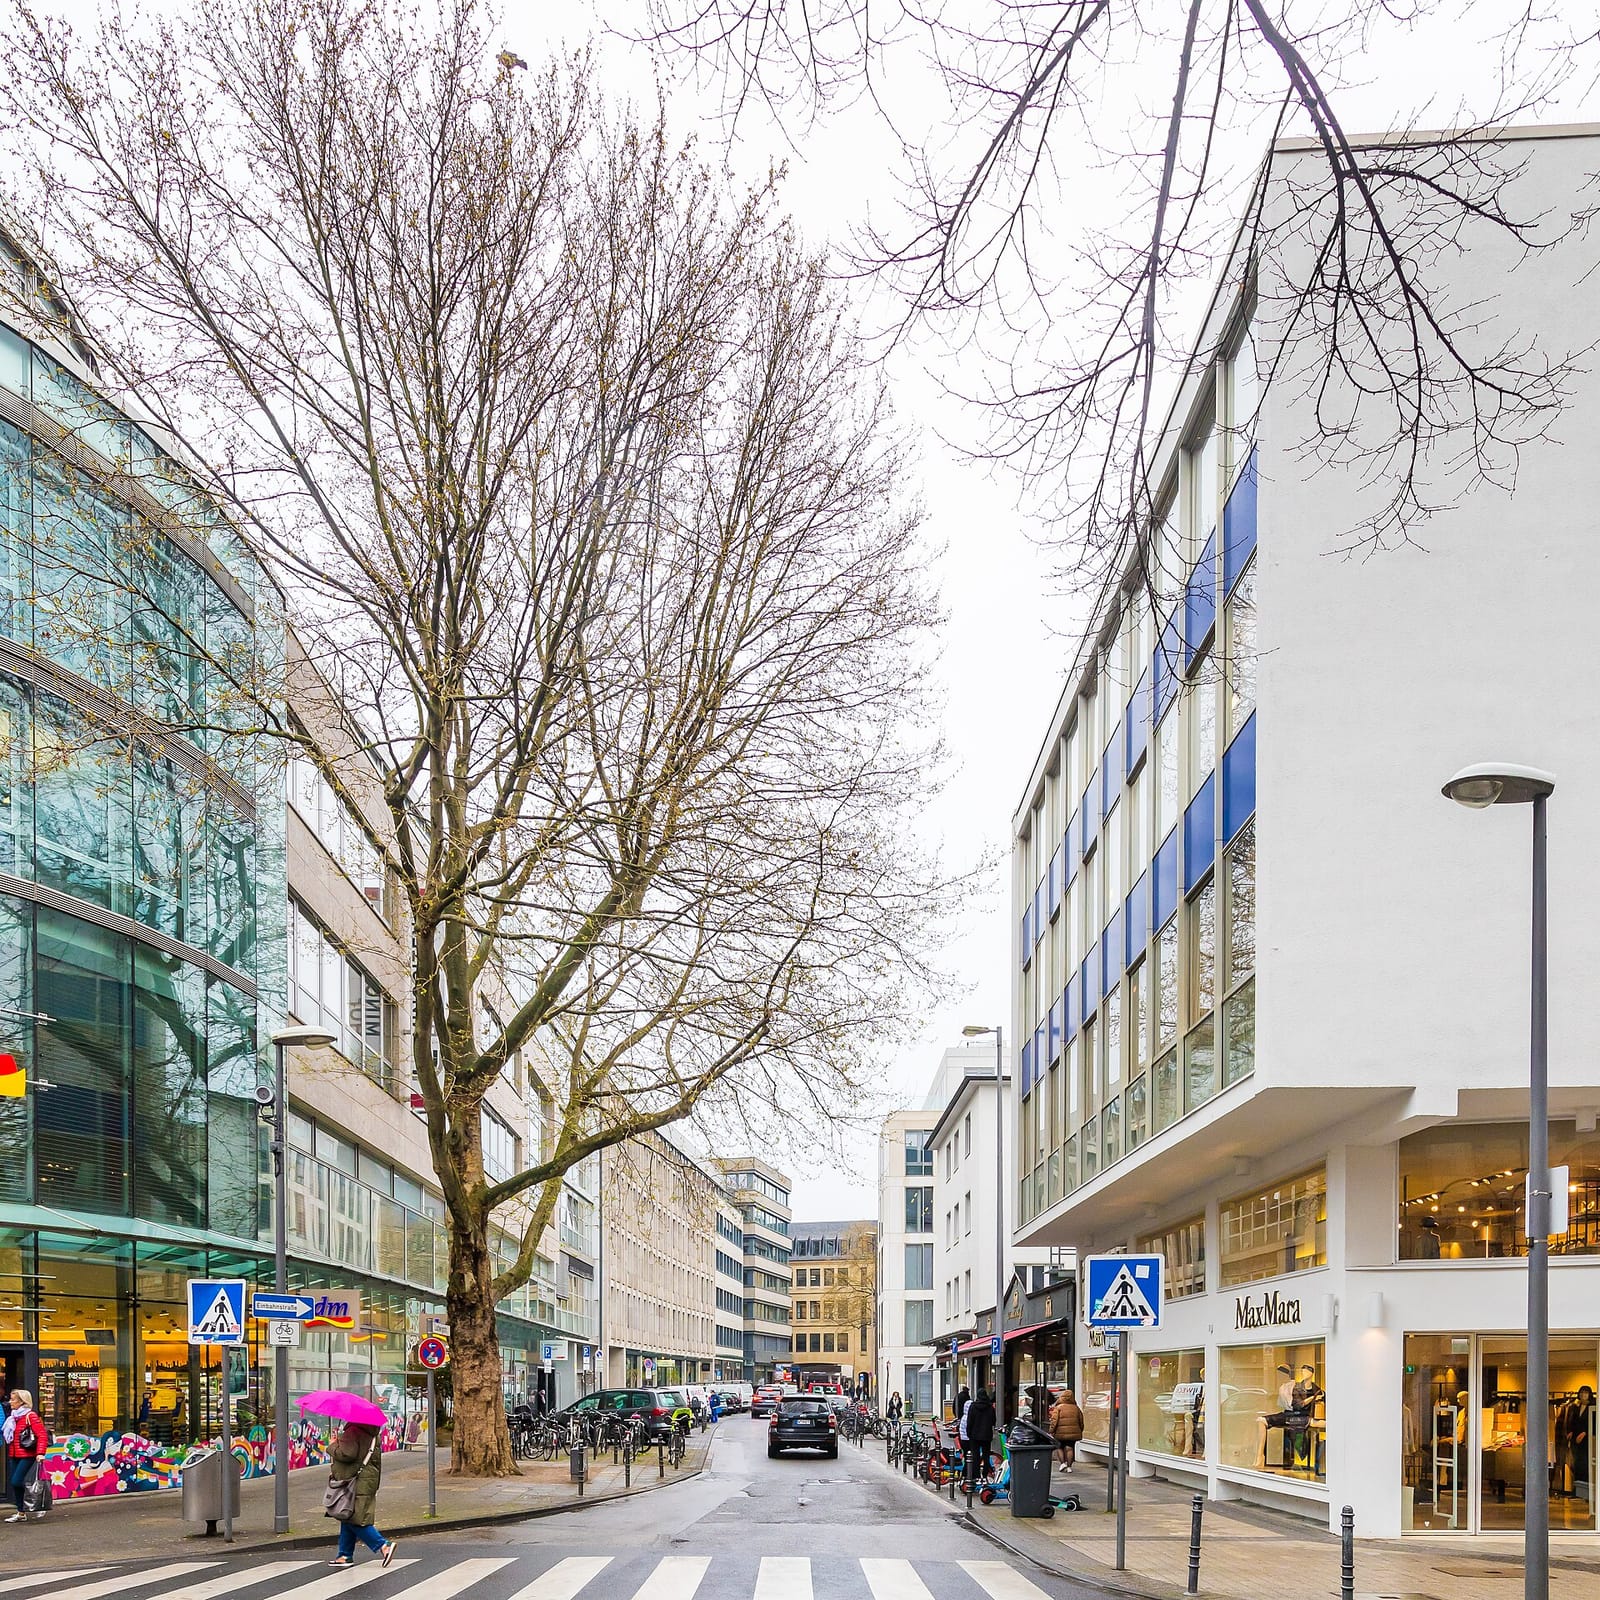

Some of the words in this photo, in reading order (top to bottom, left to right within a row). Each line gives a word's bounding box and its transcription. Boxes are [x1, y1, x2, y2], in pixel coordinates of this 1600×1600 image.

[256, 1302, 297, 1311] Einbahnstraße
[315, 1296, 348, 1316] dm
[1234, 1290, 1301, 1330] MaxMara
